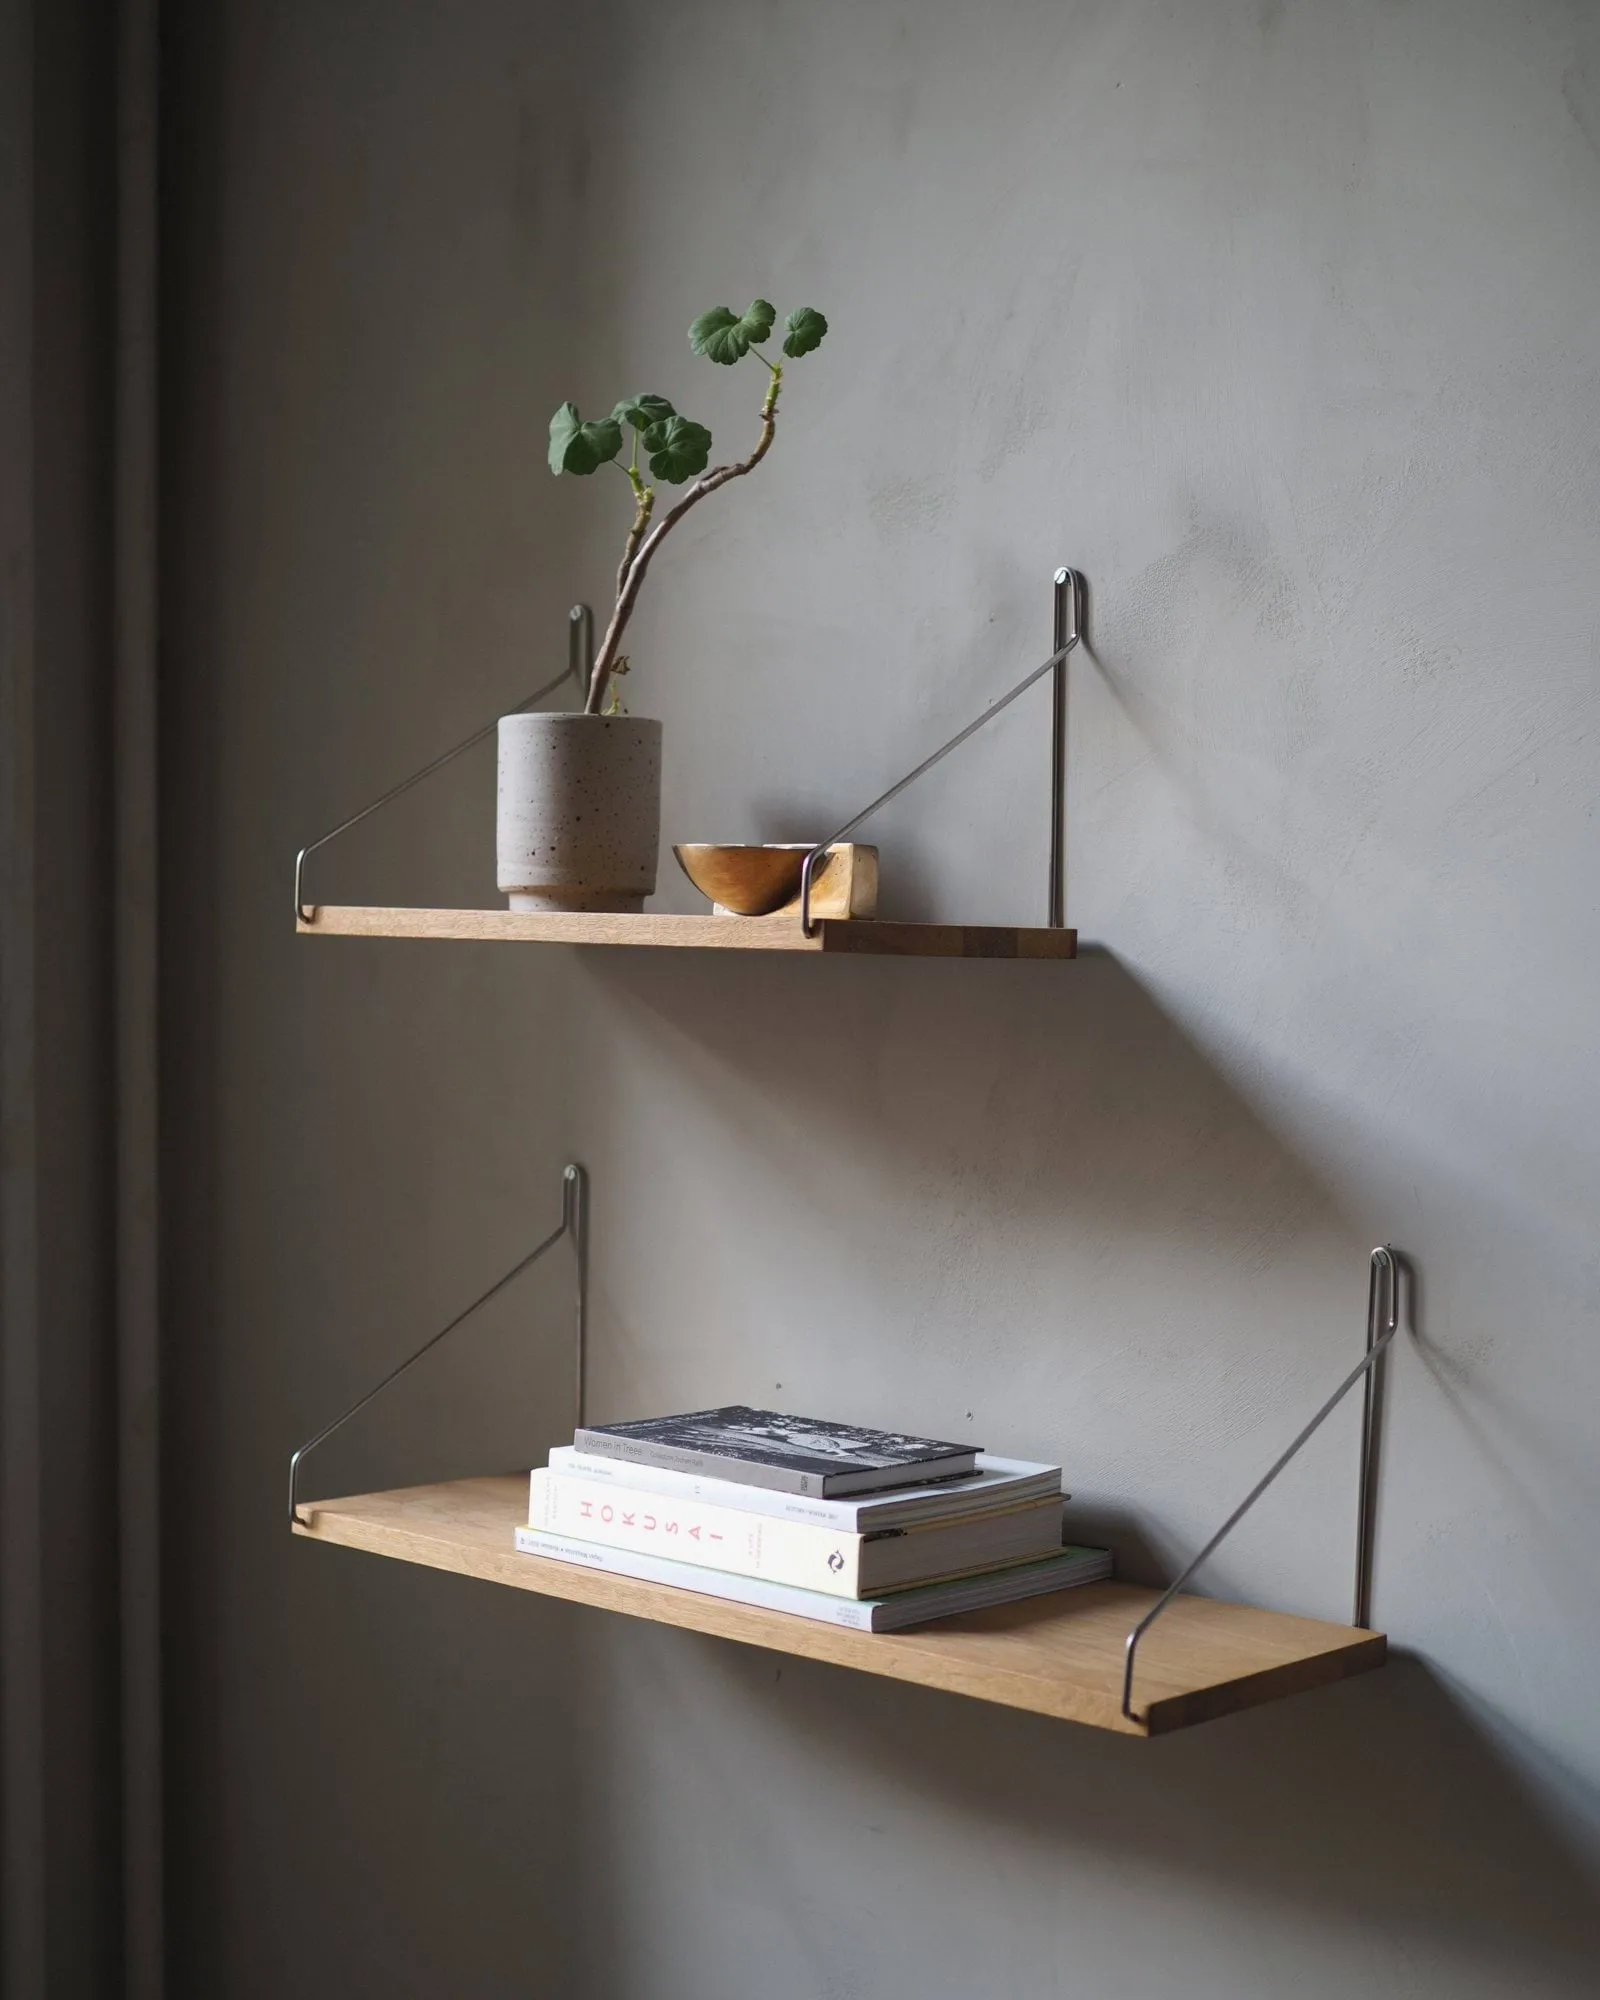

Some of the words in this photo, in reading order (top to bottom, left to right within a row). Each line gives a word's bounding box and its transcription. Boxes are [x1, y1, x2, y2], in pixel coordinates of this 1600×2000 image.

[584, 1435, 612, 1449] Women
[613, 1441, 621, 1451] in
[622, 1442, 642, 1456] Trees
[580, 1501, 723, 1541] HOKUSAI
